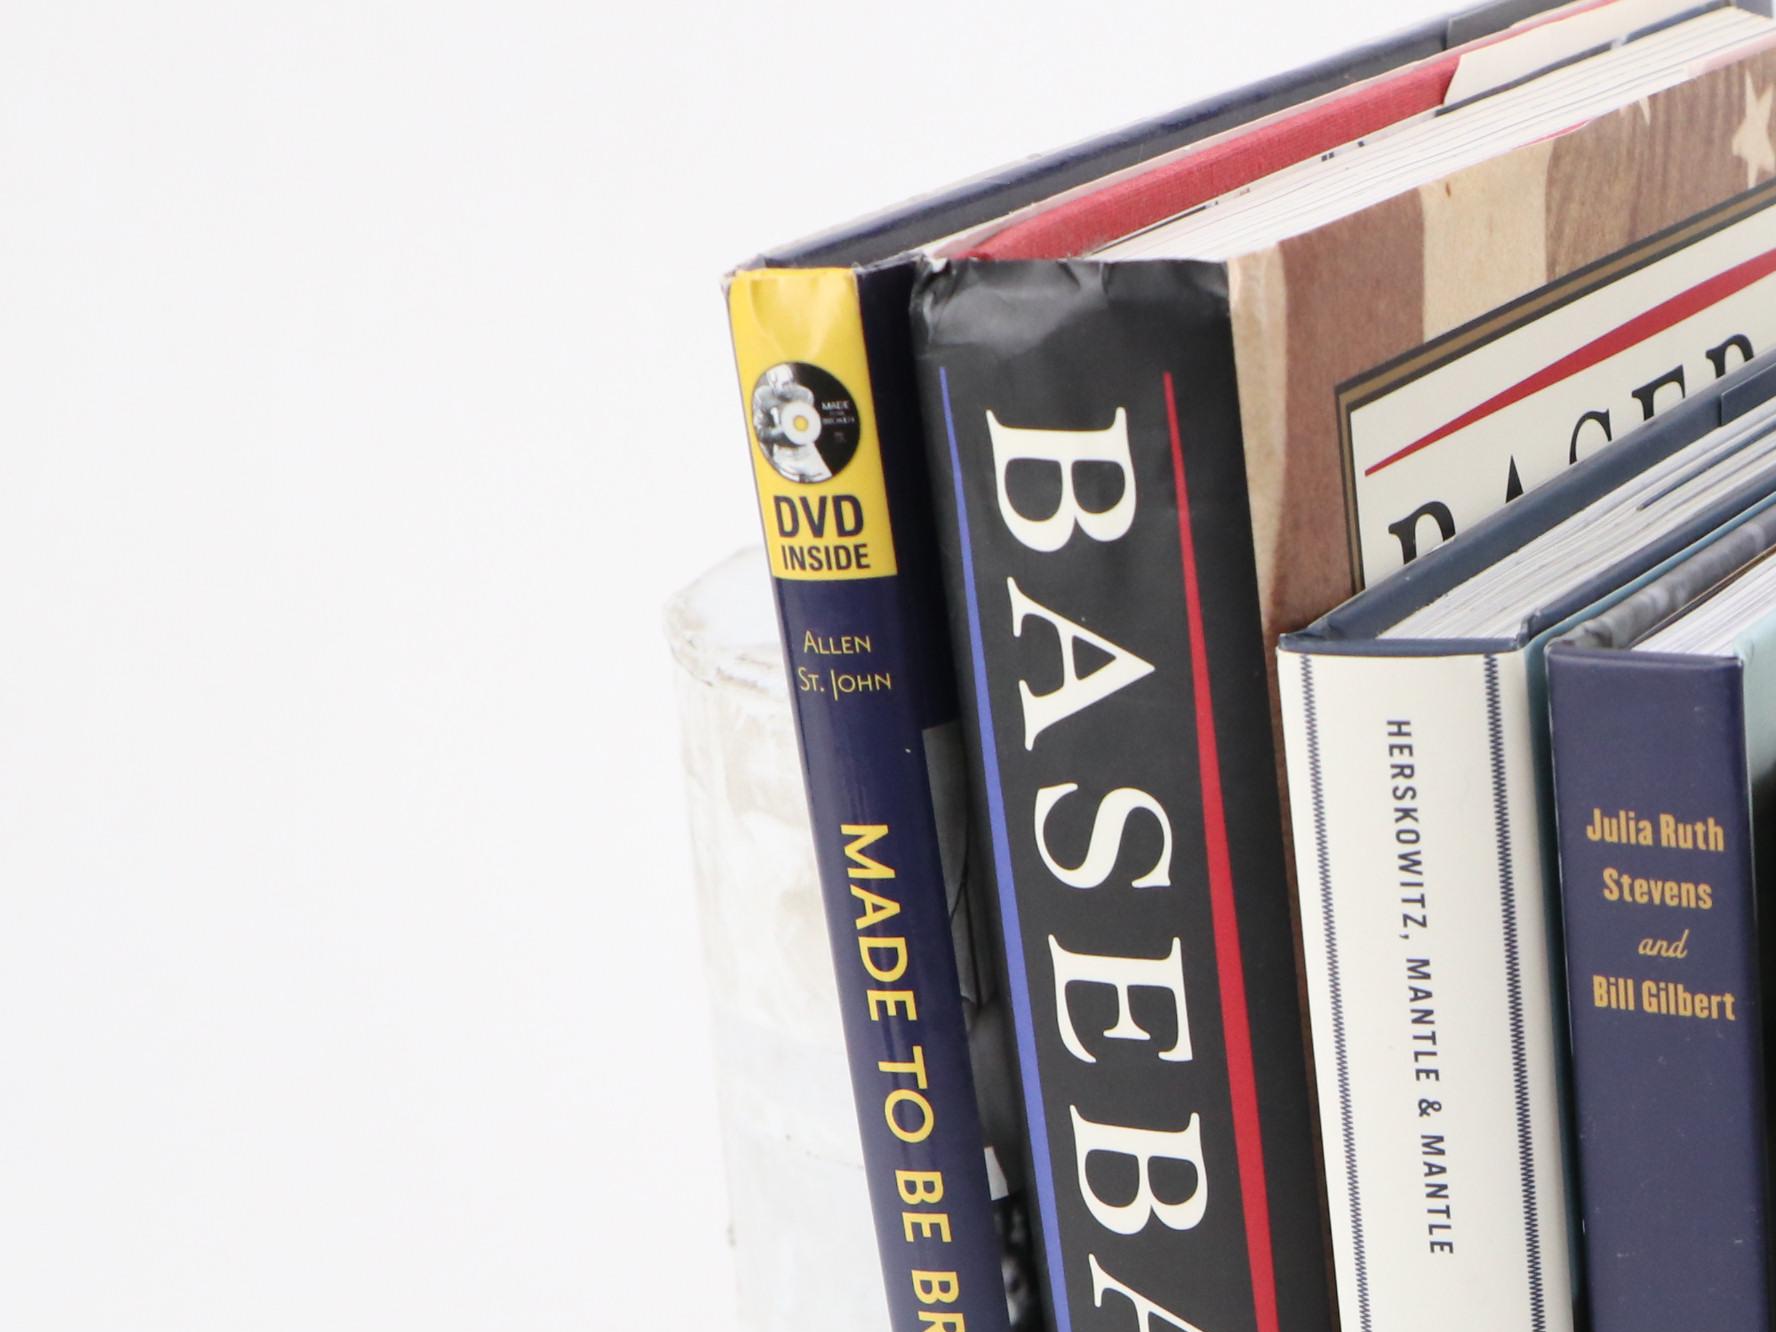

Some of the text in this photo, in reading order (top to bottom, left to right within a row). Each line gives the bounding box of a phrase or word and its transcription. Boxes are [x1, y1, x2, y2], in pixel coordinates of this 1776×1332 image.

[774, 494, 864, 538] DVD
[781, 543, 871, 571] INSIDE
[1586, 807, 1725, 852] Julia Ruth
[1602, 867, 1713, 909] Stevens
[840, 824, 918, 1023] MADE
[1637, 928, 1689, 959] and
[1386, 719, 1454, 1255] HERSKOWITZ, MANTLE & MANTLE
[1593, 974, 1736, 1021] Bill Gilbert
[878, 1046, 935, 1144] TO
[895, 1170, 952, 1243] BE
